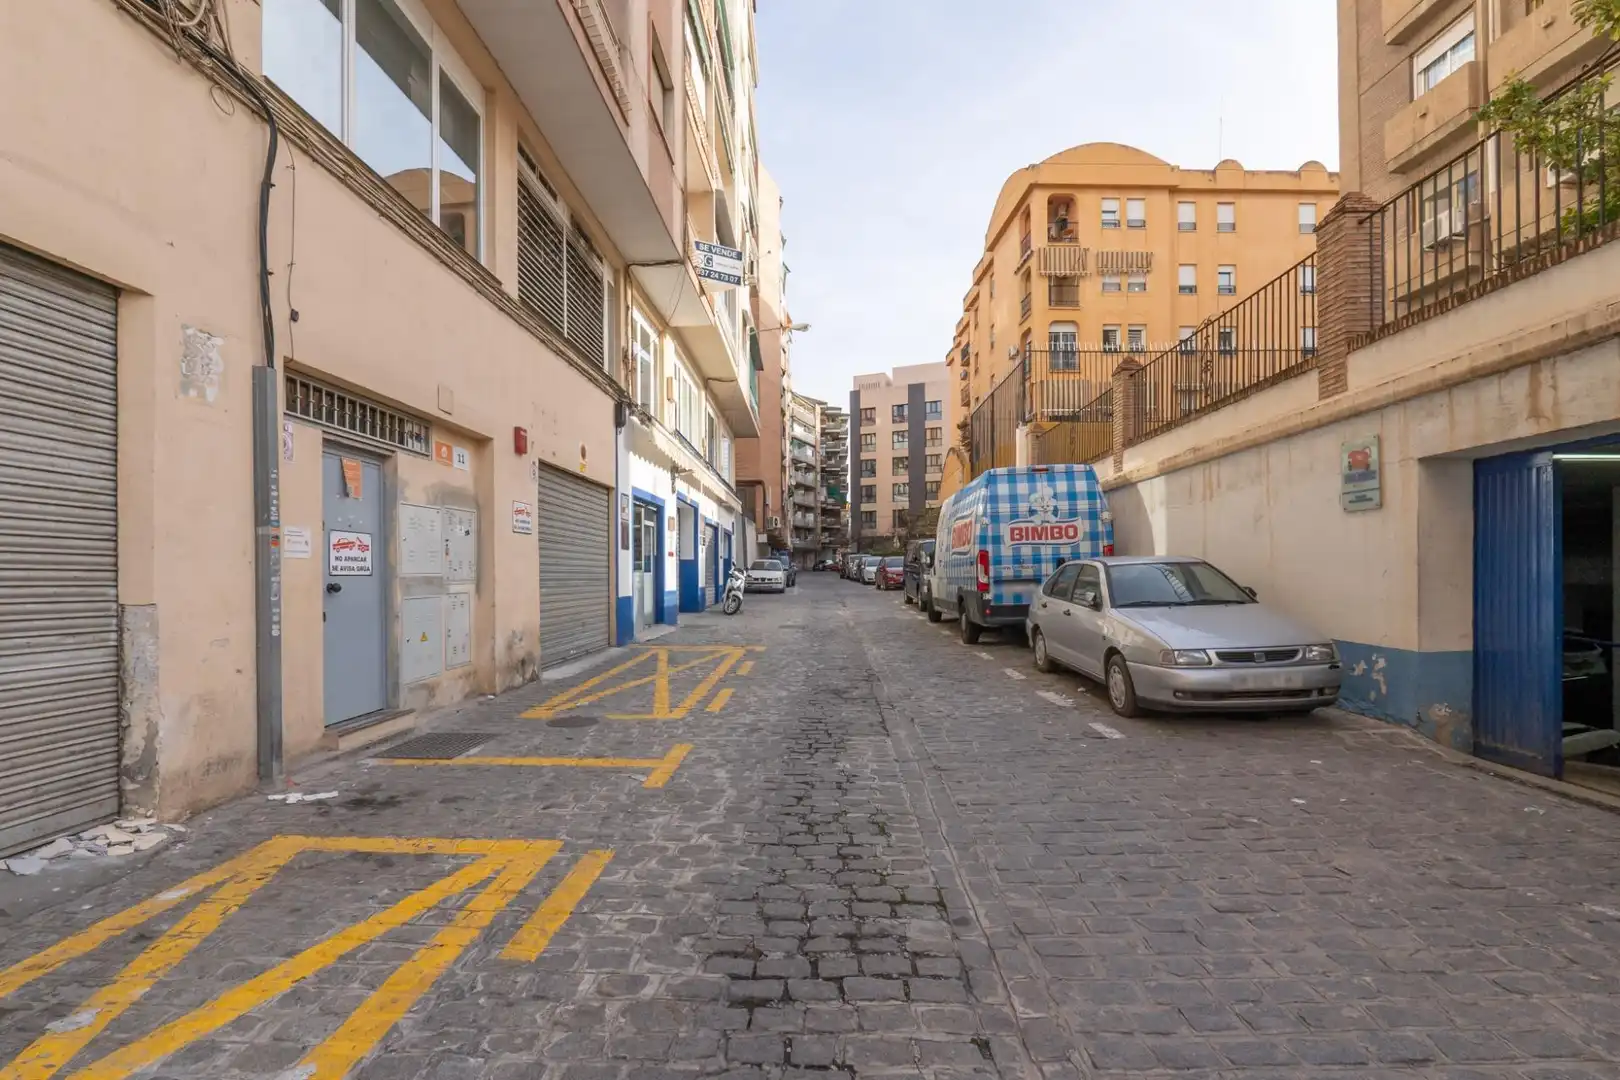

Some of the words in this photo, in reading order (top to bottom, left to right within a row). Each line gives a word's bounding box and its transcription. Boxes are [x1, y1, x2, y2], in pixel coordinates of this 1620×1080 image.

[699, 243, 710, 251] SE
[711, 245, 739, 259] VENDE
[710, 271, 719, 280] 24
[457, 453, 465, 464] 11
[952, 520, 972, 549] BIMBO
[1009, 524, 1078, 542] BIMBO
